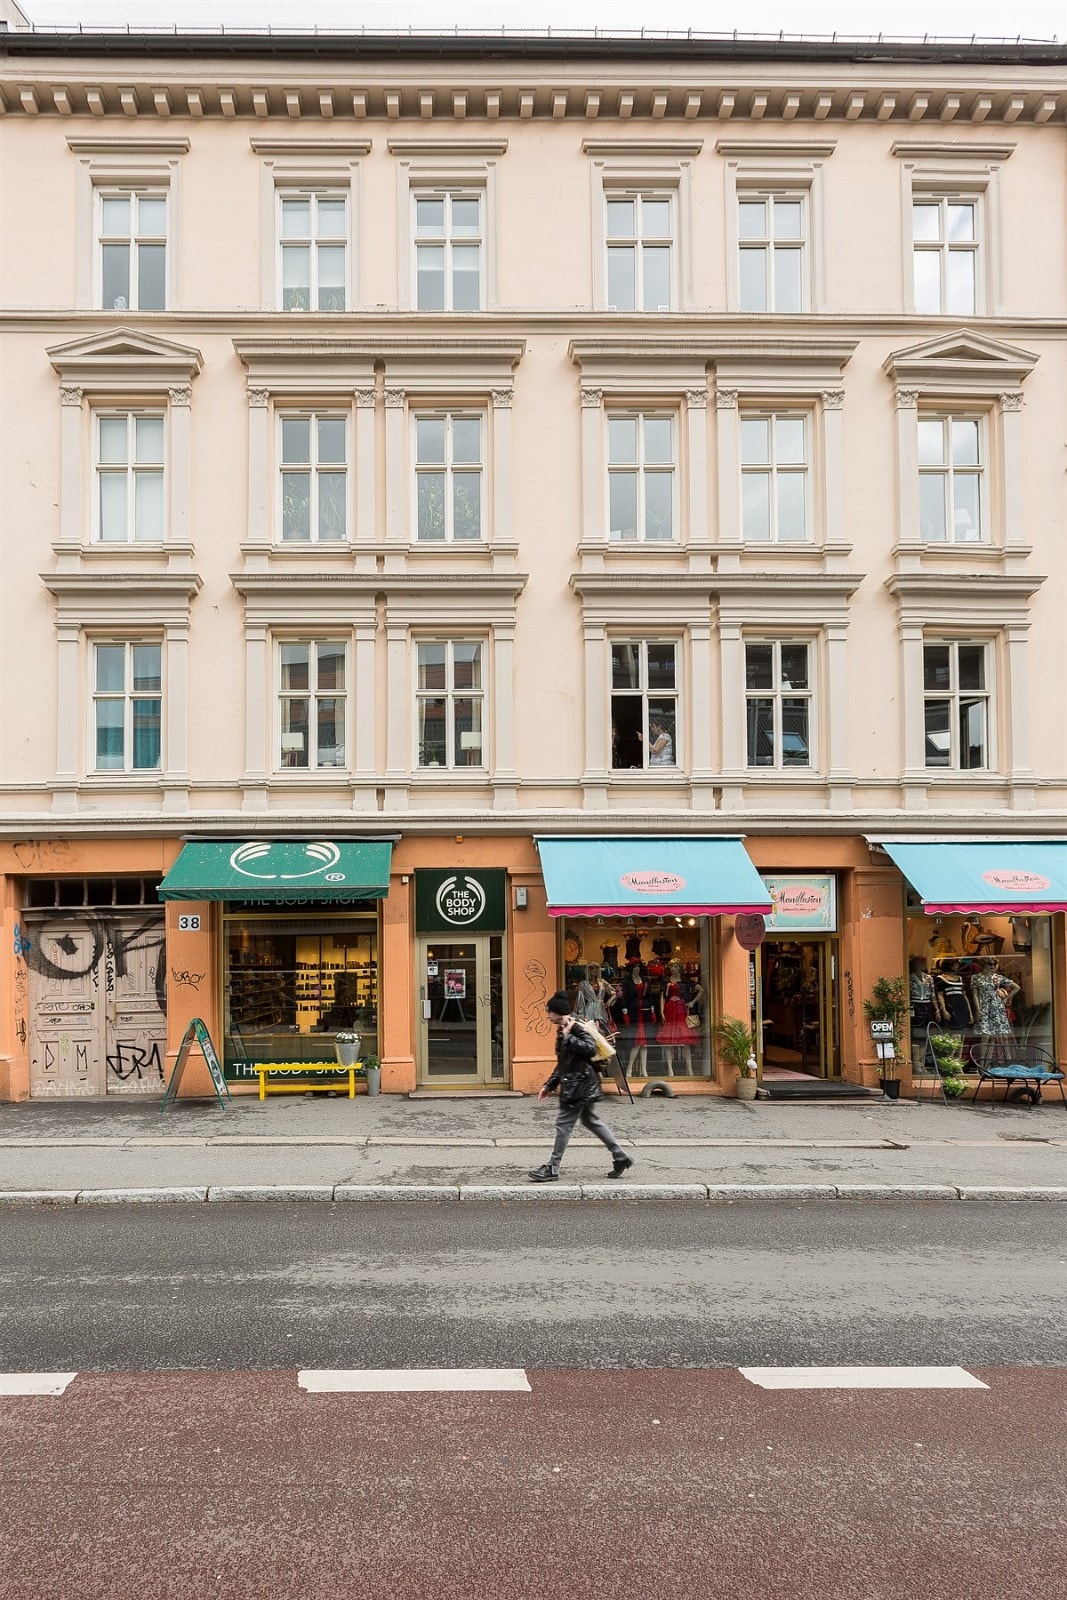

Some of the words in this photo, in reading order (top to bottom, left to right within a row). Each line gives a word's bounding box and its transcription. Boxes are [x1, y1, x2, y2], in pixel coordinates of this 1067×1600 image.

[451, 890, 470, 899] THE
[446, 899, 477, 908] BODY
[447, 907, 475, 916] SHOP
[180, 917, 200, 929] 38
[872, 1023, 893, 1032] OPEN
[233, 1063, 263, 1076] THE
